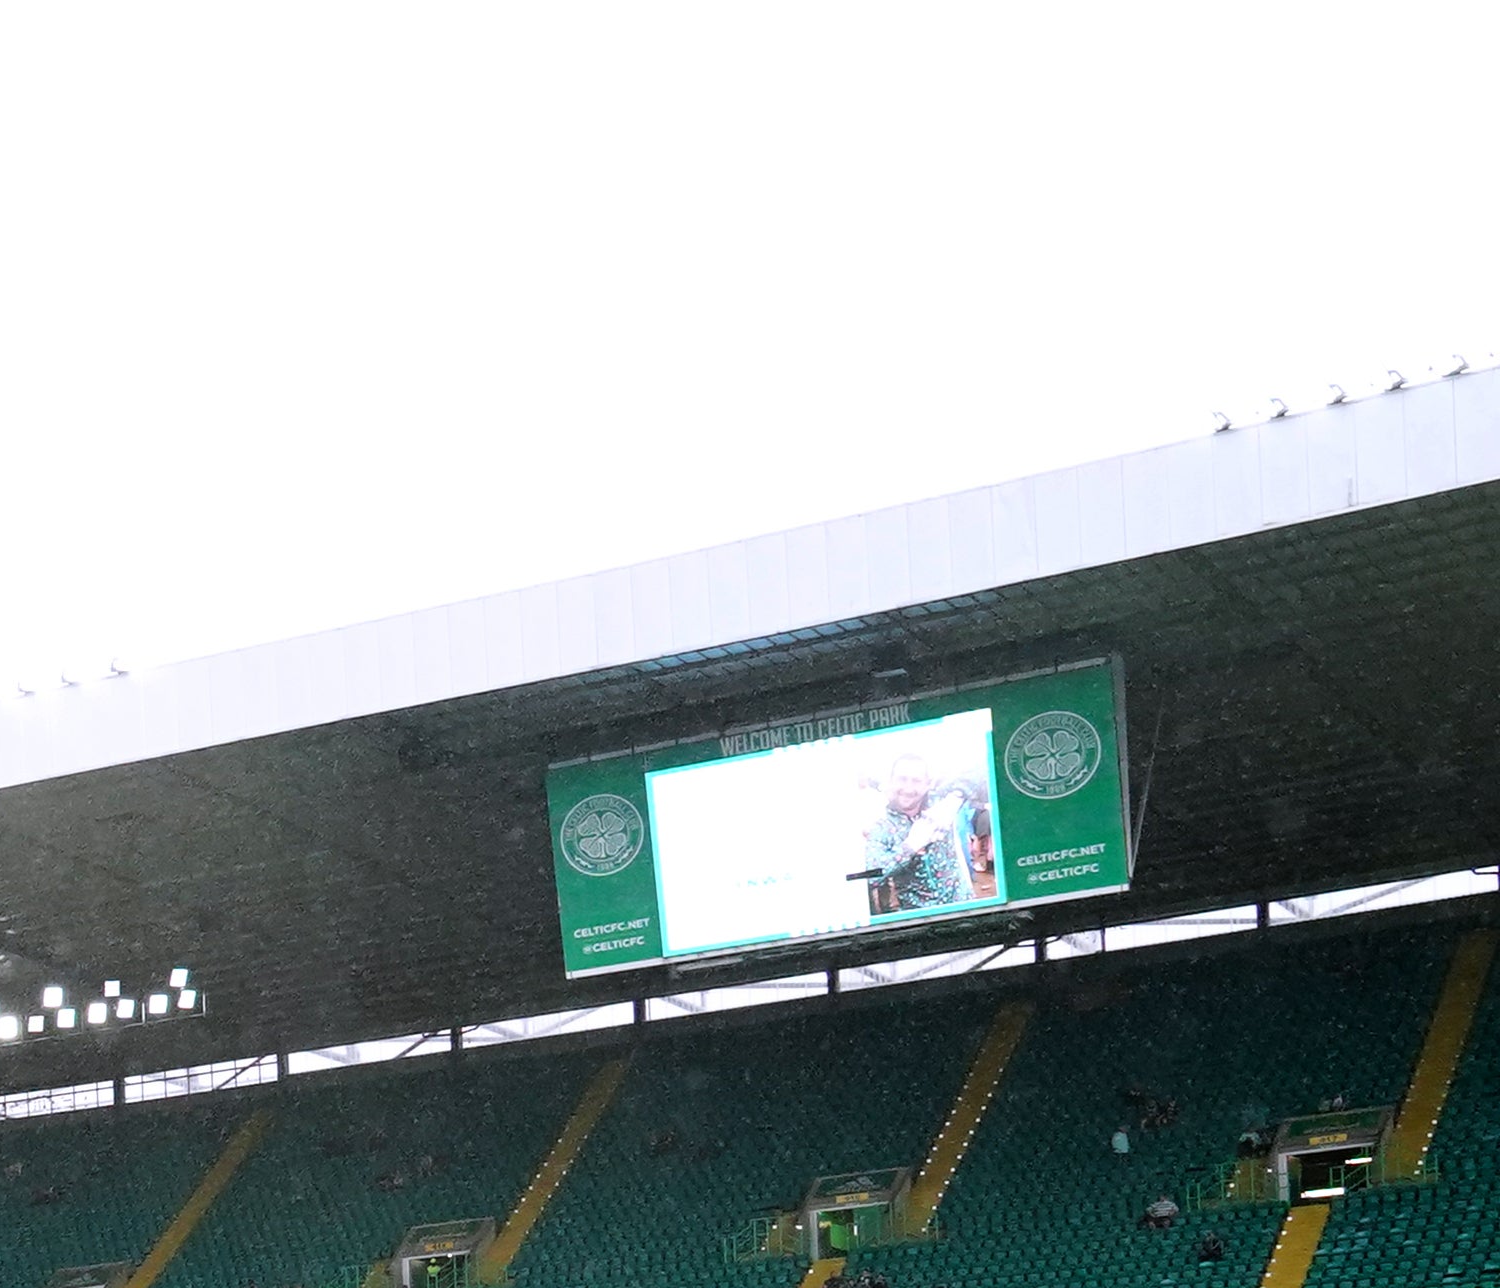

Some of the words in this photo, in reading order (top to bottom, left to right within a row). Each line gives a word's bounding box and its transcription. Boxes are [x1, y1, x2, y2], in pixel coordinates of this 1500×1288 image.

[719, 726, 790, 757] WELCOME
[794, 722, 815, 744] TO
[817, 712, 866, 739] CELTIC
[869, 703, 912, 729] PARK
[1017, 843, 1106, 867] CELTICFC.NET
[573, 917, 650, 939] CELTICFC.NET
